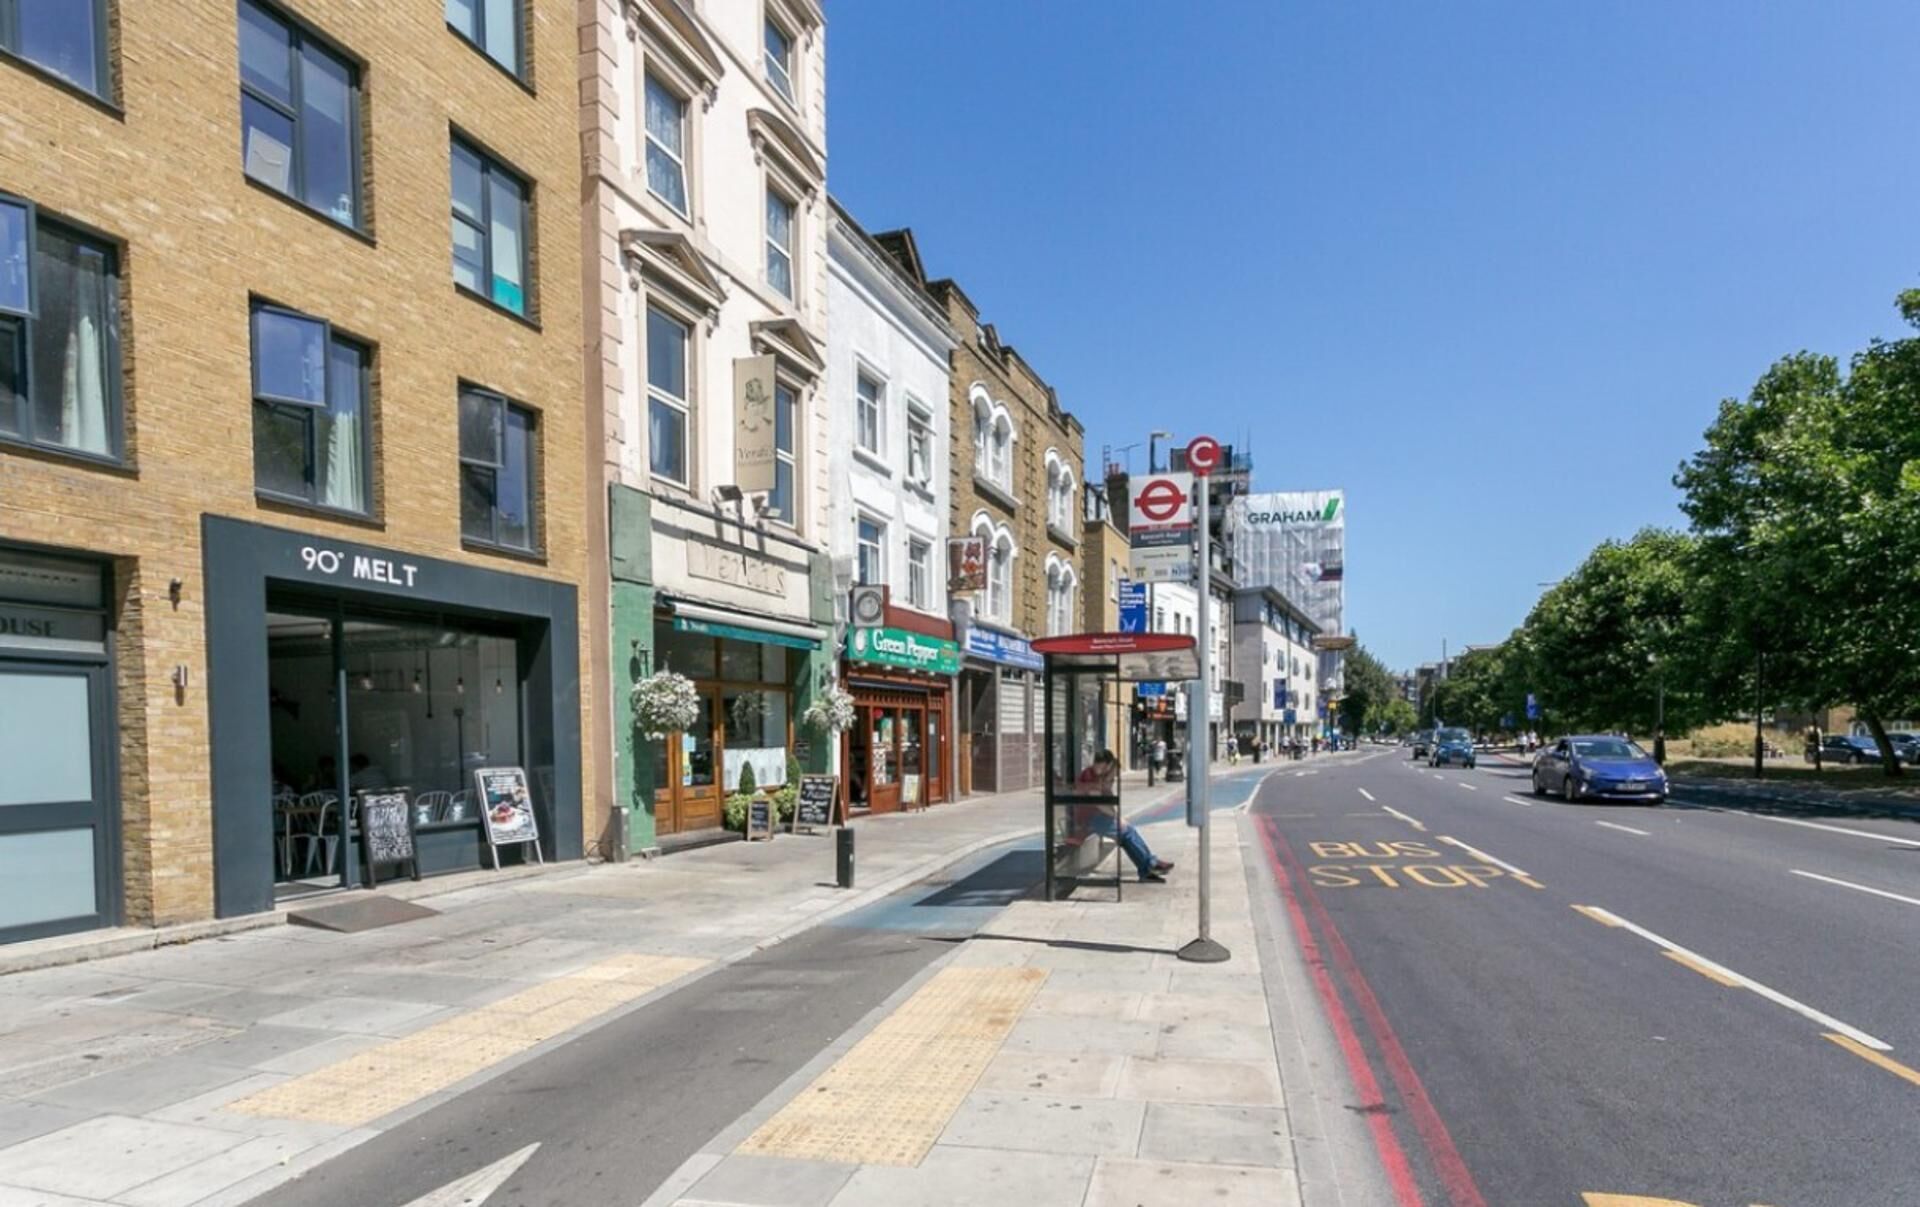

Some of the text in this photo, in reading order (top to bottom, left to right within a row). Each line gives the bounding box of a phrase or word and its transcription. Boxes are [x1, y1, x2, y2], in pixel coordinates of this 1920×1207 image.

[1191, 441, 1213, 467] C
[1247, 509, 1321, 525] GRAHAM
[353, 556, 418, 587] MELT
[872, 629, 906, 655] Green
[906, 636, 939, 665] Pepper
[1308, 841, 1441, 859] BUS
[1308, 864, 1504, 888] STOP
